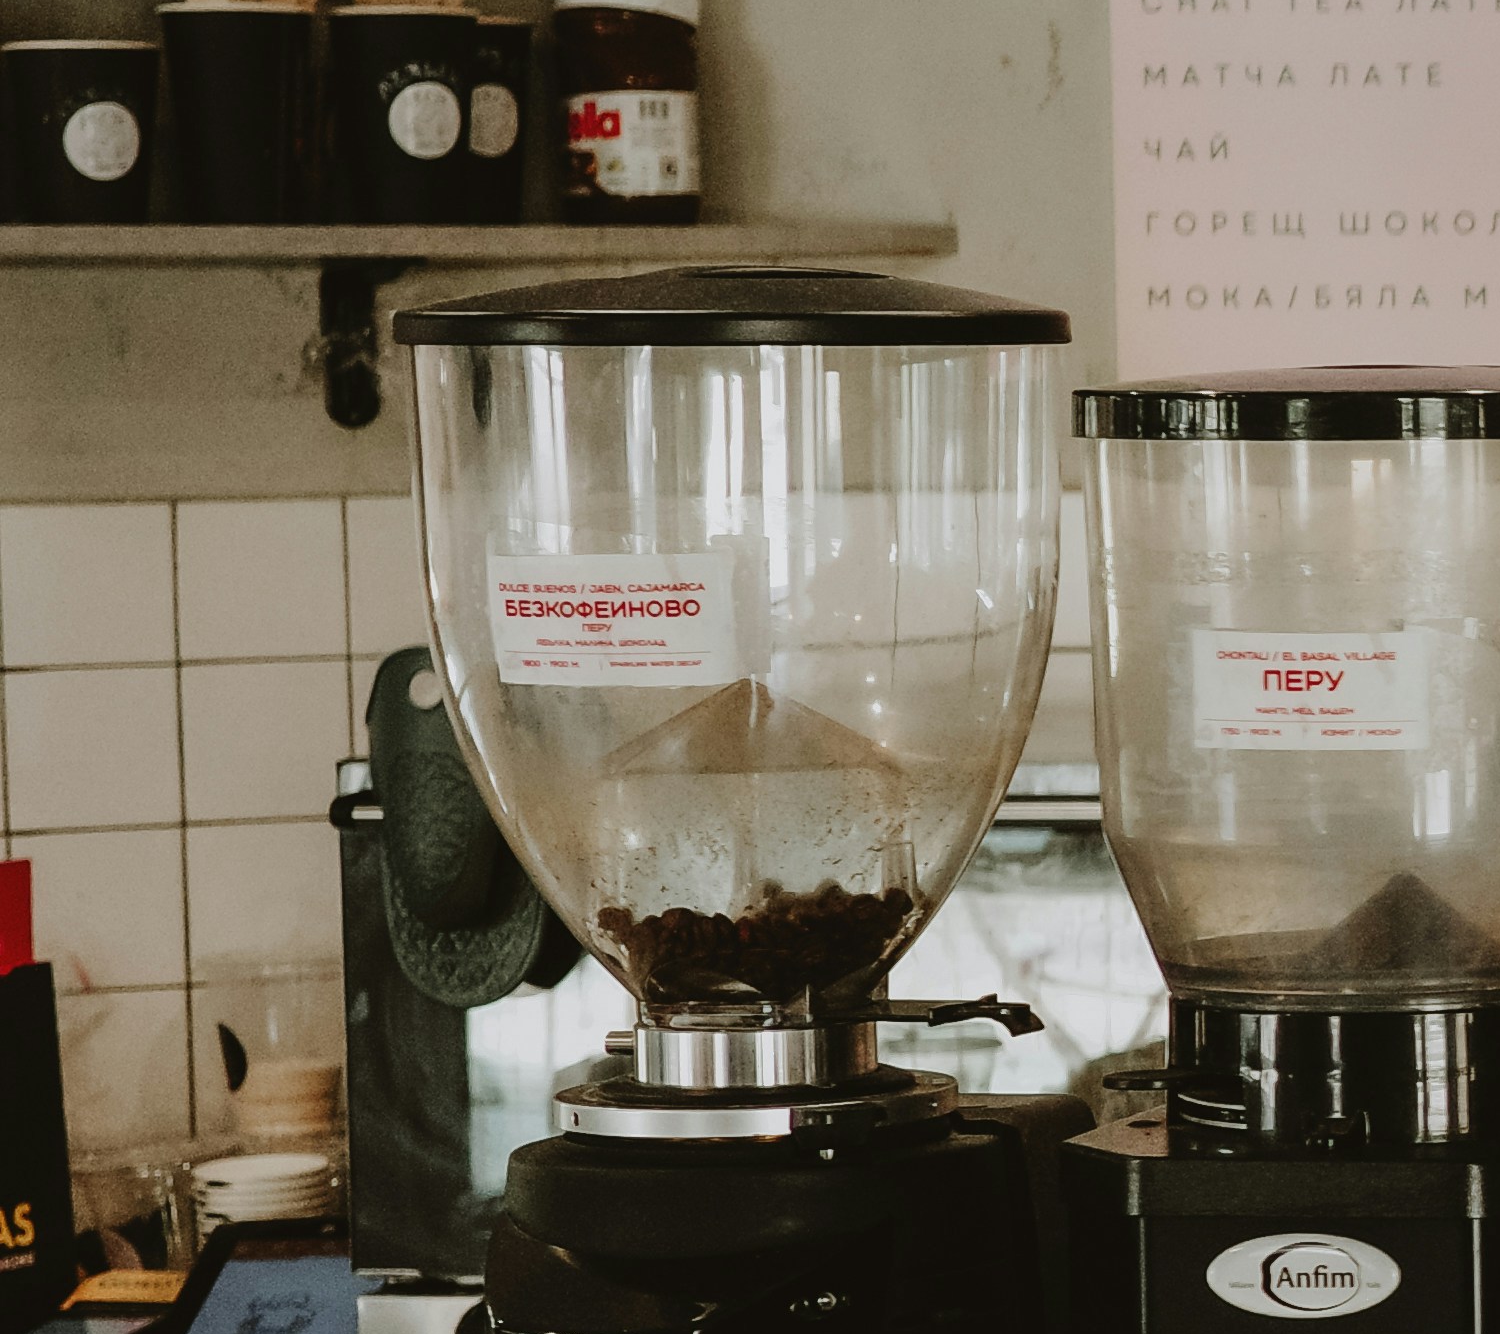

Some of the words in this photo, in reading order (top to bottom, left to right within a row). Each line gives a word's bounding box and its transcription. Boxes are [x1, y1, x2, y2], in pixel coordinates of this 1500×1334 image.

[1143, 63, 1296, 86] МАТЧА
[1329, 62, 1441, 87] ЛАТЕ
[1144, 133, 1229, 161] ЧАЙ
[1145, 210, 1306, 239] ГОРЕЩ
[1146, 285, 1430, 310] МОКА/БЯЛА
[581, 623, 613, 633] ПЕРУ
[1263, 670, 1344, 692] ПЕРУ
[1277, 1265, 1355, 1289] Anfim
